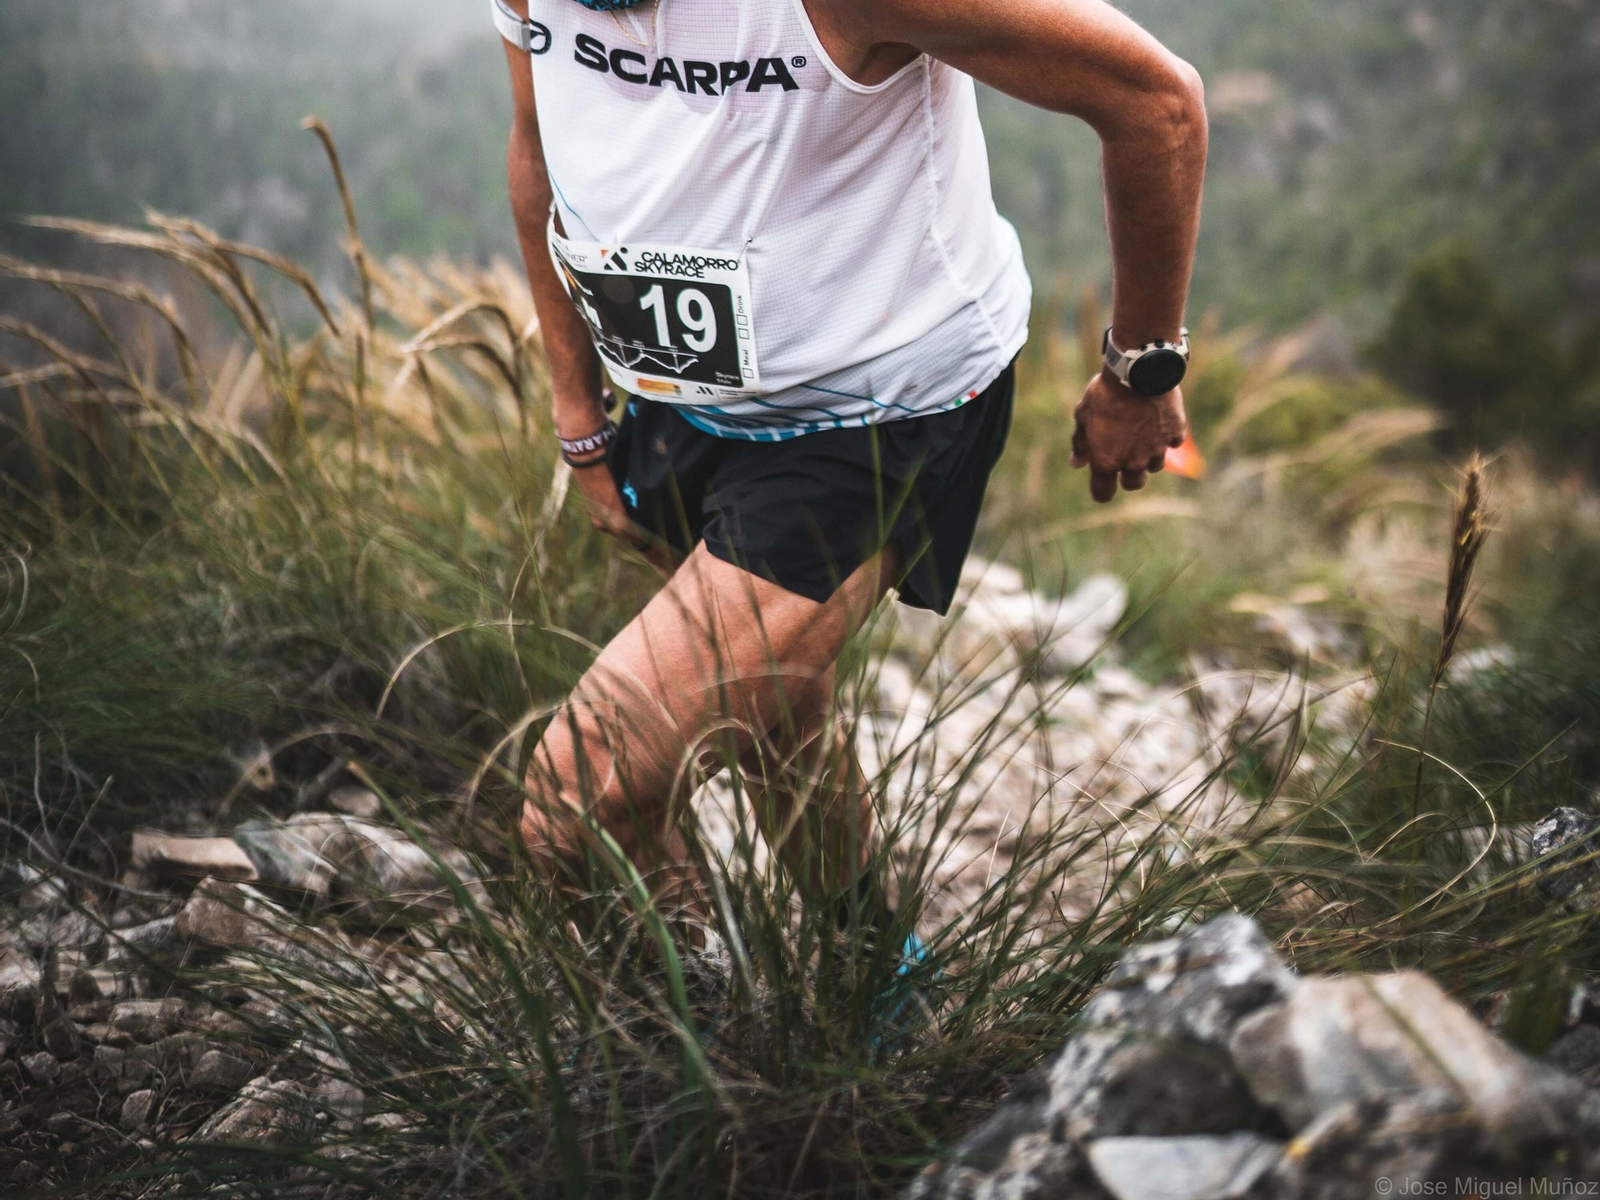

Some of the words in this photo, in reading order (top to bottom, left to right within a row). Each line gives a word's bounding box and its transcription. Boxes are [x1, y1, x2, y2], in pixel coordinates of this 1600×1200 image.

[634, 261, 705, 279] SKYRACE
[641, 251, 739, 272] CALAMORRO
[736, 294, 744, 314] Drink
[639, 284, 717, 353] 19
